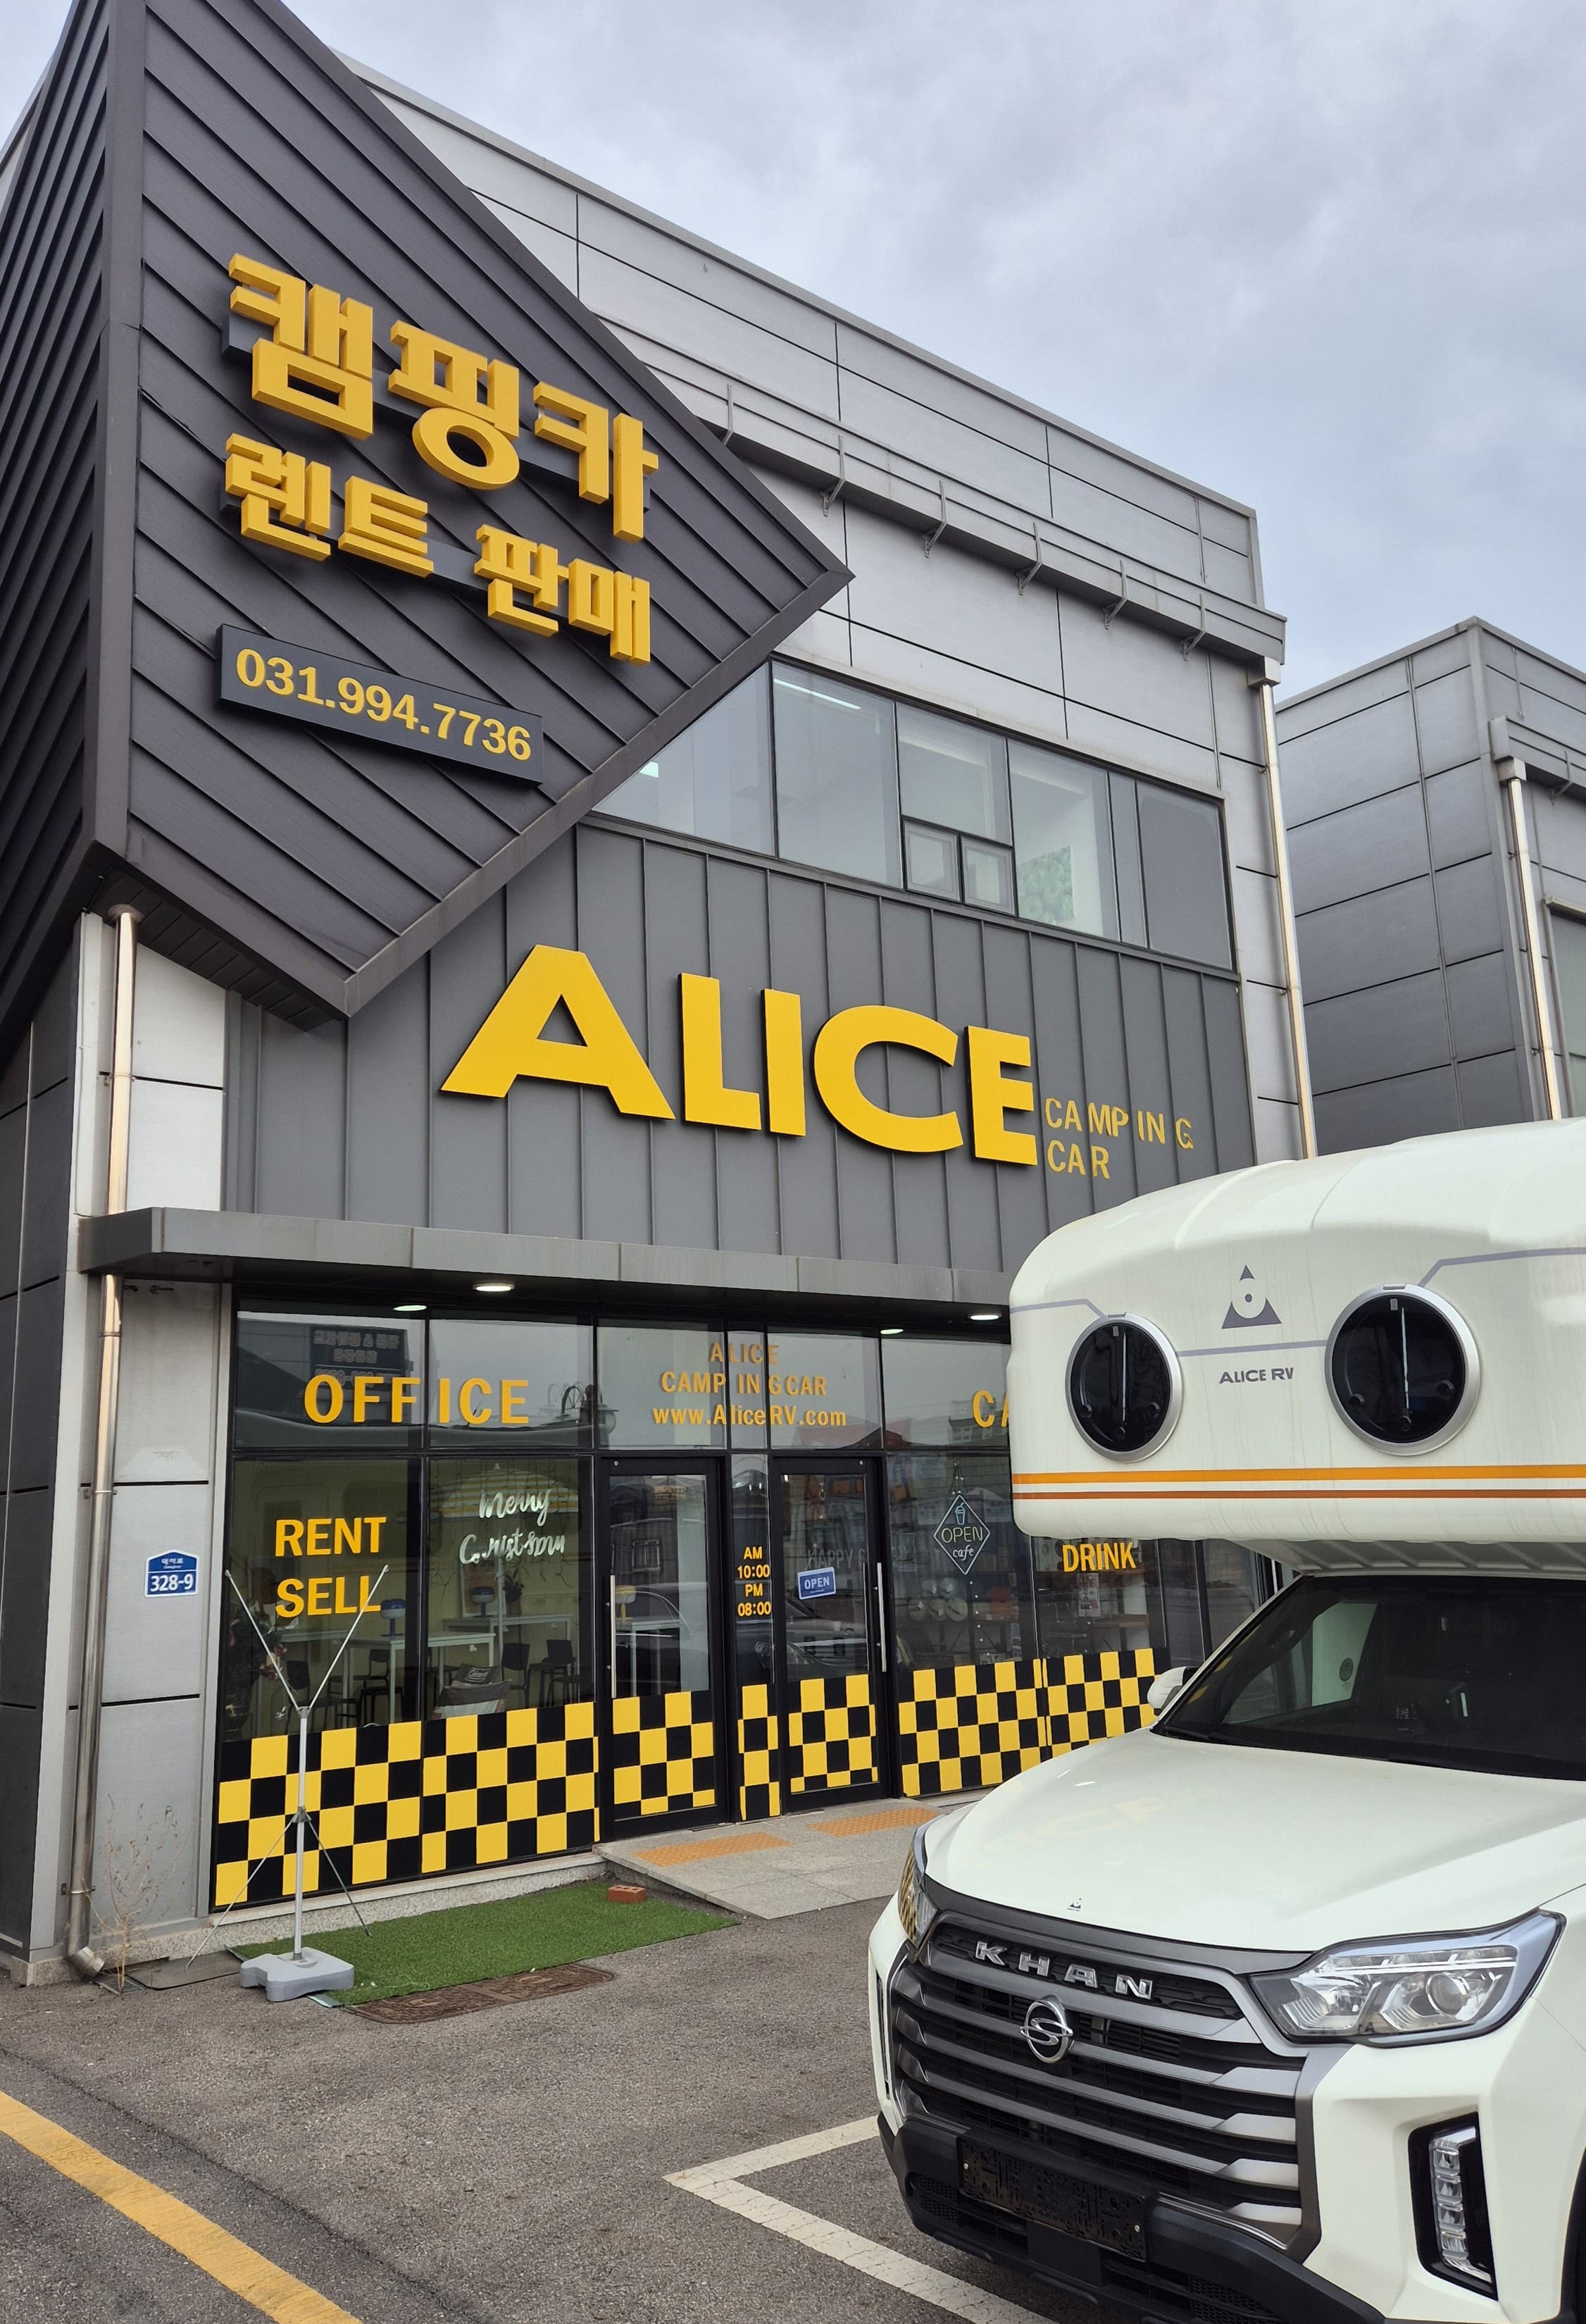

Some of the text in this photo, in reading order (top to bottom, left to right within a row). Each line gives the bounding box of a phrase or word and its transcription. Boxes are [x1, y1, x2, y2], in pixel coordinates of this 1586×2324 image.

[228, 252, 658, 541] 캠핑카
[225, 433, 651, 665] 렌트 판매
[236, 649, 531, 761] 031.994.7736
[440, 945, 1038, 1167] ALICE
[1044, 1098, 1194, 1150] CAMPING
[1047, 1140, 1110, 1179] CAR
[709, 1342, 779, 1365] ALICE
[1219, 1367, 1294, 1384] ALICE RV
[304, 1374, 529, 1424] OFFICE
[275, 1516, 387, 1557] RENT
[941, 1526, 983, 1543] OPEN
[743, 1546, 763, 1560] AM
[952, 1544, 974, 1561] cafe
[1062, 1541, 1137, 1572] DRINK
[150, 1573, 194, 1592] 328-9
[737, 1564, 770, 1579] 10:00
[804, 1576, 830, 1589] OPEN
[275, 1574, 382, 1618] SELL
[744, 1583, 763, 1597] PM
[737, 1601, 772, 1617] 08:00
[975, 1941, 1153, 2000] KHAN
